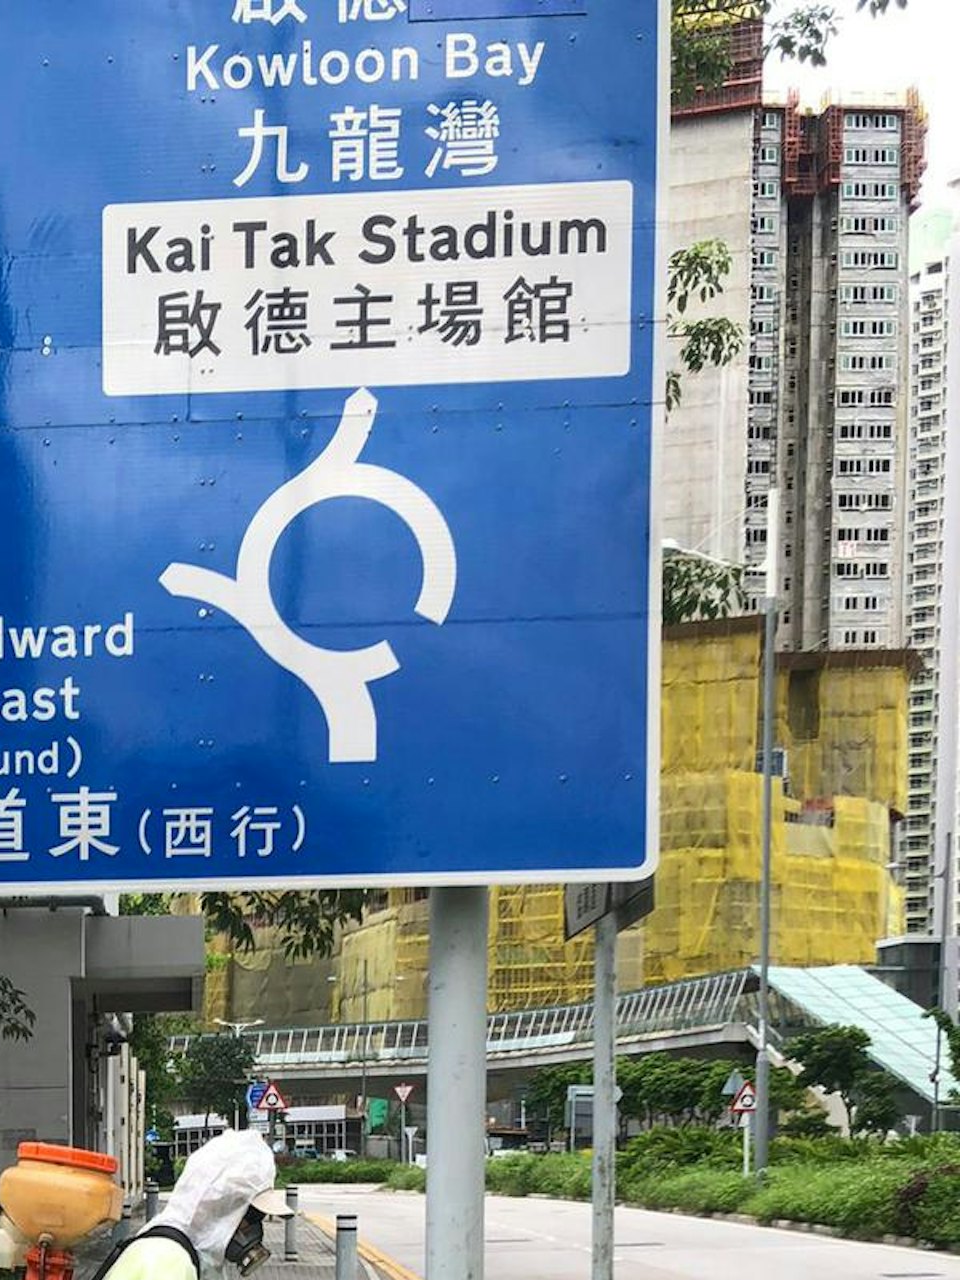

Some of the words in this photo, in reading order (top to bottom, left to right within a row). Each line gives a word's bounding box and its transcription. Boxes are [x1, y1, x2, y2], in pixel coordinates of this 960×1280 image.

[187, 40, 419, 92] Kowloon
[445, 32, 545, 86] Bay
[232, 99, 501, 189] 九龍灣
[126, 224, 212, 274] Kai
[232, 219, 336, 269] Tak
[358, 209, 607, 265] Stadium
[152, 275, 574, 359] 啟德主場館
